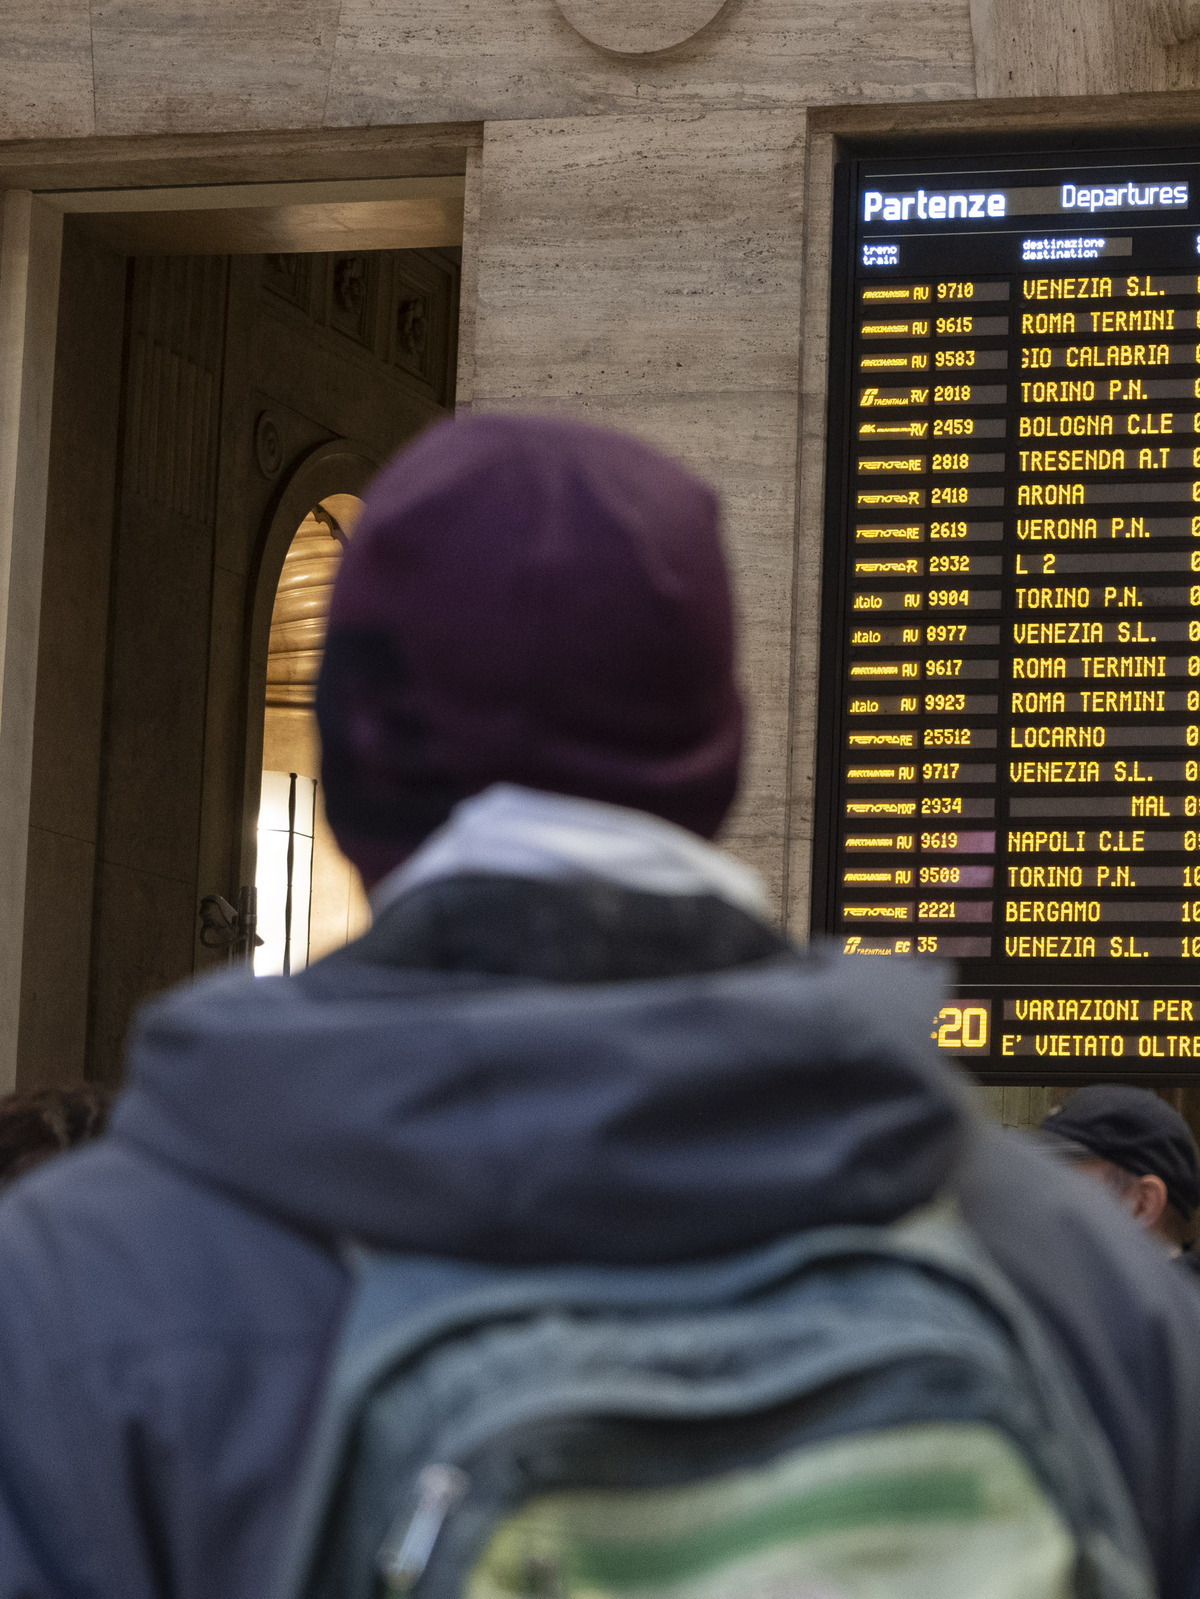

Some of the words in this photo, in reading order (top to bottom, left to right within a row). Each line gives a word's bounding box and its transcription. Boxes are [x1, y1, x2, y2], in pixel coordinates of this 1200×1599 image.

[864, 189, 1006, 222] Partenze
[1061, 182, 1189, 213] Departures
[863, 244, 898, 255] treno
[1022, 237, 1106, 250] destinazione
[863, 254, 898, 265] train
[1022, 248, 1098, 260] destination
[912, 286, 930, 300] AV
[937, 282, 974, 299] 9710
[1022, 277, 1113, 300] VENEZIA
[1126, 275, 1165, 297] S.L.
[912, 321, 929, 335] AV
[935, 316, 973, 334] 9615
[1021, 312, 1076, 335] ROMA
[1090, 309, 1175, 333] TERMINI
[911, 355, 928, 369] AV
[935, 350, 976, 368] 9583
[1066, 344, 1170, 368] CALABRIA
[934, 385, 971, 401] 2018
[1020, 380, 1095, 403] TORINO
[1109, 379, 1148, 401] P.N.
[933, 418, 974, 435] 2459
[1019, 414, 1114, 438] BOLOGNA
[1127, 412, 1174, 435] C.LE
[931, 453, 970, 470] 2818
[1018, 448, 1125, 472] TRESENDA
[1138, 447, 1171, 470] A.T
[931, 487, 969, 504] 2418
[1017, 483, 1085, 506] ARONA
[930, 521, 968, 539] 2619
[1016, 518, 1097, 541] VERONA
[1111, 517, 1150, 539] P.N.
[929, 555, 970, 573] 2932
[1015, 553, 1029, 575] L
[1042, 553, 1056, 575] 2
[903, 593, 921, 609] AV
[928, 589, 969, 607] 9904
[1015, 587, 1090, 609] TORINO
[1104, 586, 1143, 608] P.N.
[902, 628, 920, 643] AV
[926, 624, 967, 642] 8977
[1013, 622, 1103, 645] VENEZIA
[1117, 621, 1157, 643] S.L.
[900, 662, 918, 678] AV
[925, 659, 963, 676] 9617
[1012, 657, 1067, 679] ROMA
[1080, 656, 1167, 678] TERMINI
[899, 697, 917, 712] AV
[924, 694, 966, 711] 9923
[1011, 691, 1066, 714] ROMA
[1079, 690, 1166, 713] TERMINI
[923, 728, 971, 746] 25512
[1010, 726, 1106, 748] LOCARNO
[898, 766, 915, 781] AV
[922, 762, 960, 780] 9717
[1009, 761, 1100, 783] VENEZIA
[1114, 760, 1153, 782] S.L.
[921, 797, 962, 814] 2934
[1131, 795, 1171, 817] MAL
[896, 835, 912, 850] AV
[920, 832, 959, 849] 9619
[1007, 830, 1086, 853] NAPOLI
[1098, 830, 1145, 852] C.LE
[894, 870, 912, 885] AV
[919, 866, 961, 884] 9508
[1007, 866, 1083, 888] TORINO
[1096, 865, 1136, 887] P.N.
[918, 901, 956, 918] 2221
[1005, 901, 1101, 922] BERGAMO
[917, 936, 938, 953] 35
[1005, 936, 1096, 958] VENEZIA
[1109, 936, 1149, 958] S.L.
[1015, 999, 1140, 1021] VARIAZIONI
[1152, 999, 1194, 1022] PER
[1035, 1034, 1125, 1057] VIETATO
